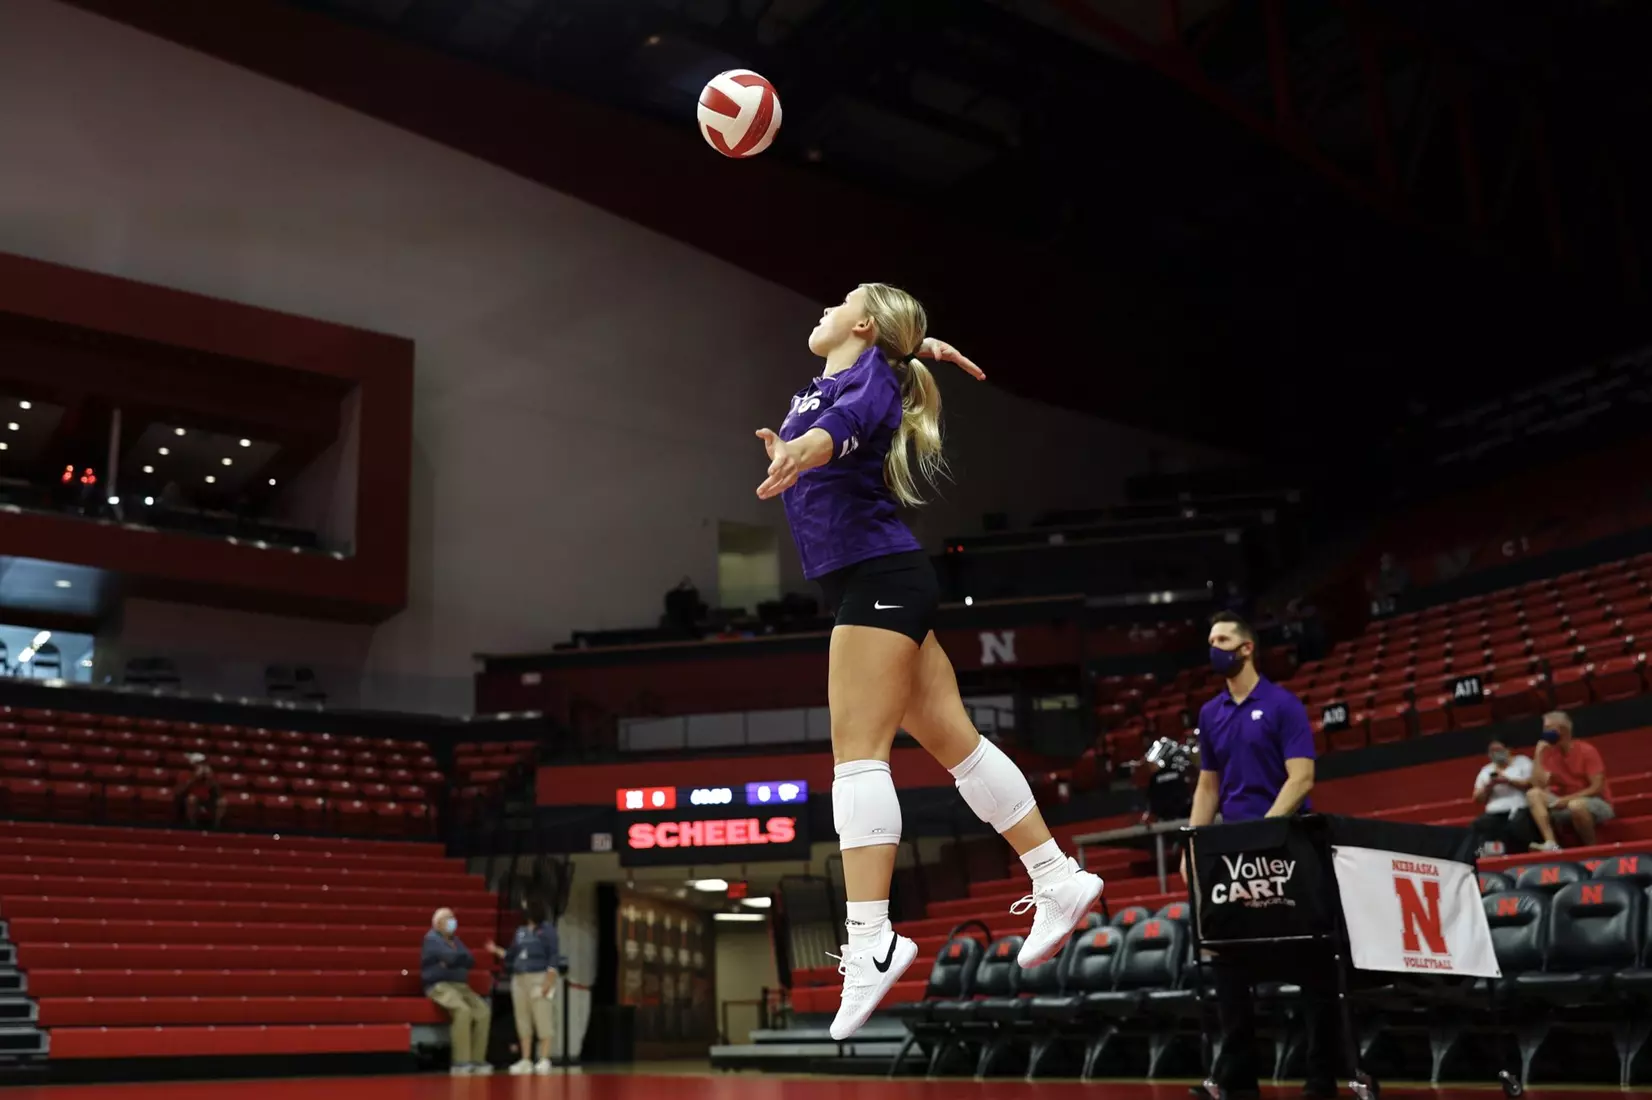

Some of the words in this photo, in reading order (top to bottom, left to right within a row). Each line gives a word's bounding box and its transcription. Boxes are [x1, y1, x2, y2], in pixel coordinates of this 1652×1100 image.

[979, 631, 1018, 665] N
[1455, 678, 1480, 698] A11
[628, 817, 796, 849] SCHEELS
[1221, 852, 1296, 880] Volley
[1391, 859, 1440, 877] NEBRASKA
[1211, 876, 1287, 904] CART
[1393, 873, 1451, 956] N
[1403, 956, 1453, 970] VOLLEYBALL
